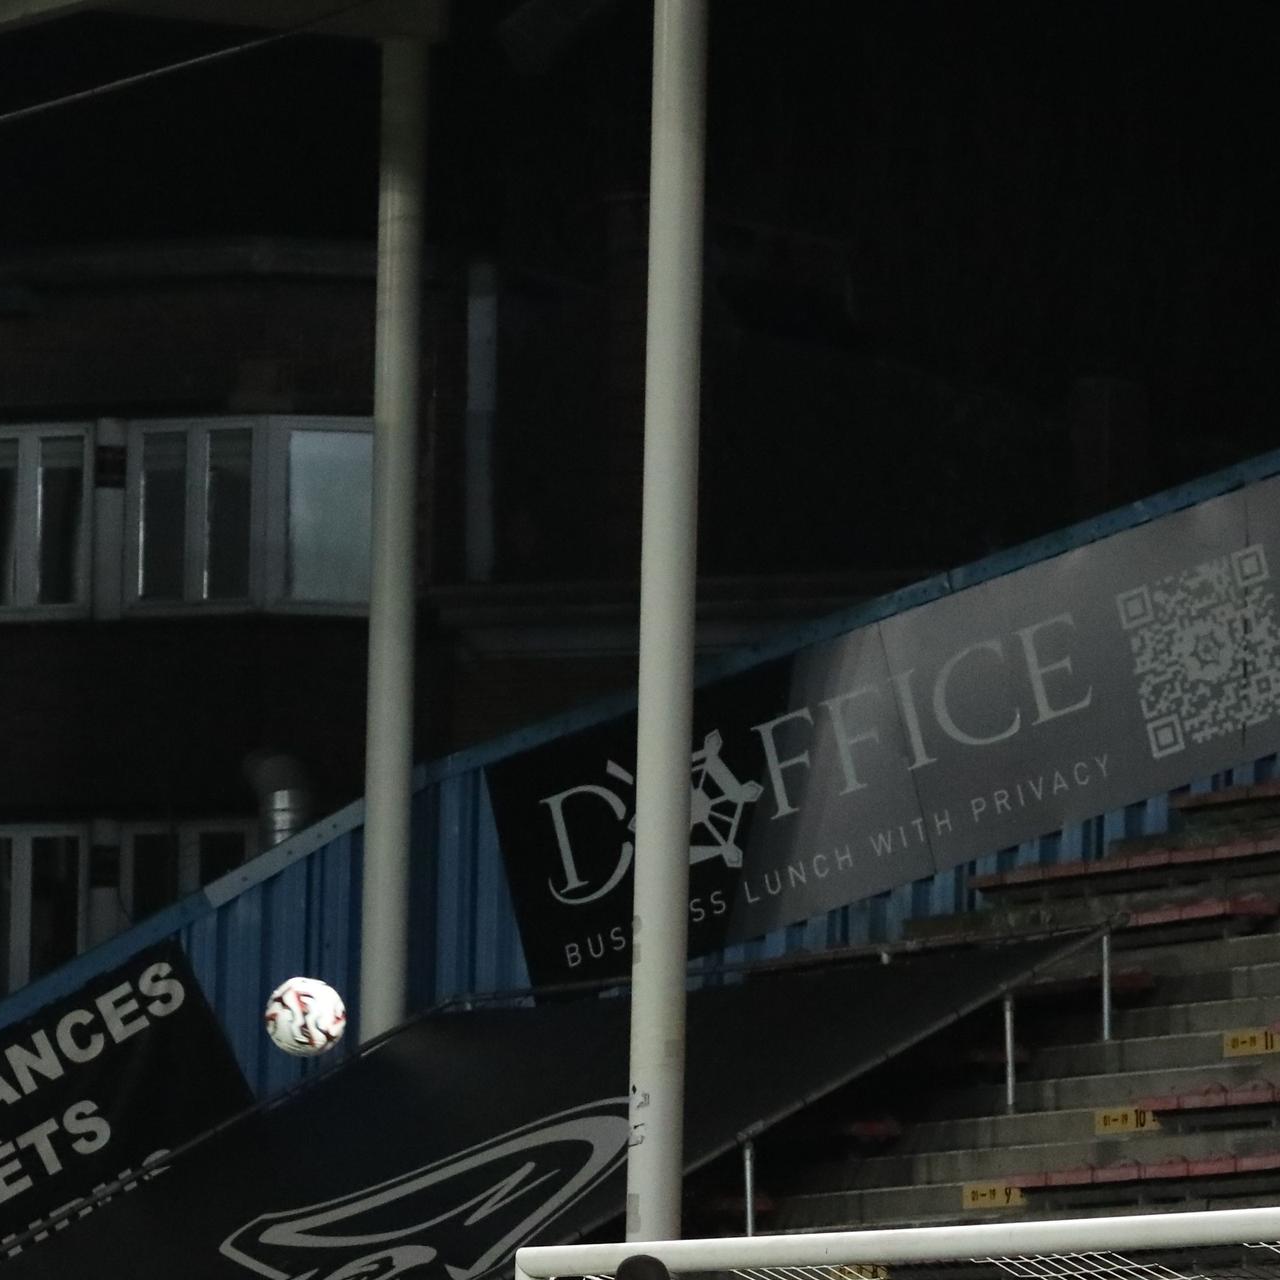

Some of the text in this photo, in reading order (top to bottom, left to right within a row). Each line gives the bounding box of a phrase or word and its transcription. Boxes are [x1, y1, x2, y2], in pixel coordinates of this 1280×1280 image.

[564, 753, 1112, 968] BUSSS LUNCH WITH PRIVACY
[1134, 1109, 1147, 1128] 10
